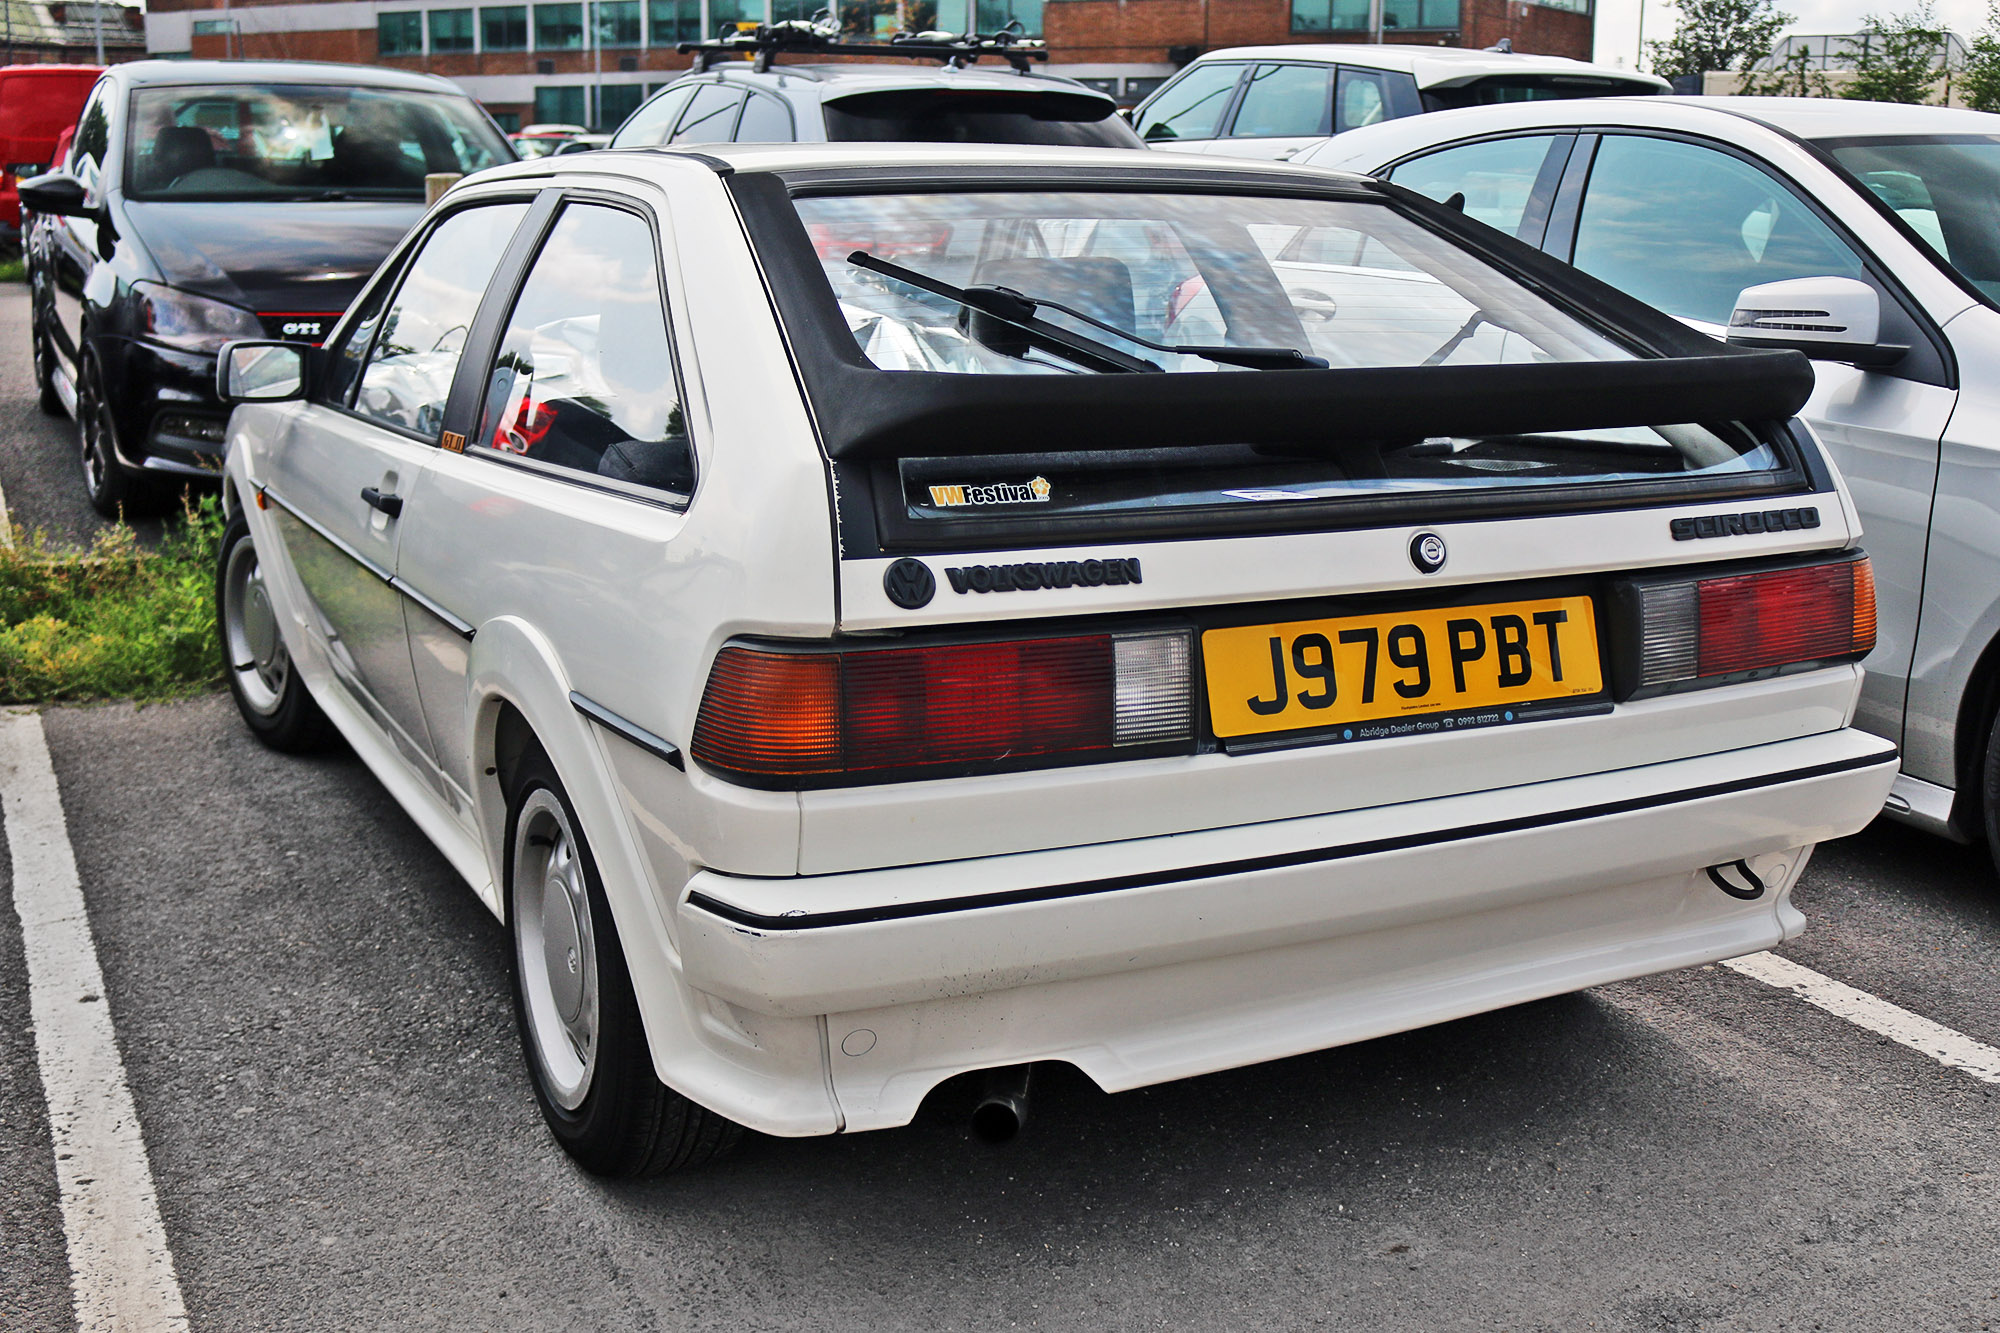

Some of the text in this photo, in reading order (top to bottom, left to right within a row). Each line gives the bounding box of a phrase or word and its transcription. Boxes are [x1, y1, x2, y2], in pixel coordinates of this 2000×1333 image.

[282, 322, 321, 335] GTI
[1670, 506, 1821, 541] SCIROCCO
[944, 557, 1143, 595] VOLKSWAGEN
[1246, 609, 1568, 716] J979 PBT
[1359, 713, 1500, 738] Abridge Dealer Group 0992 812722
